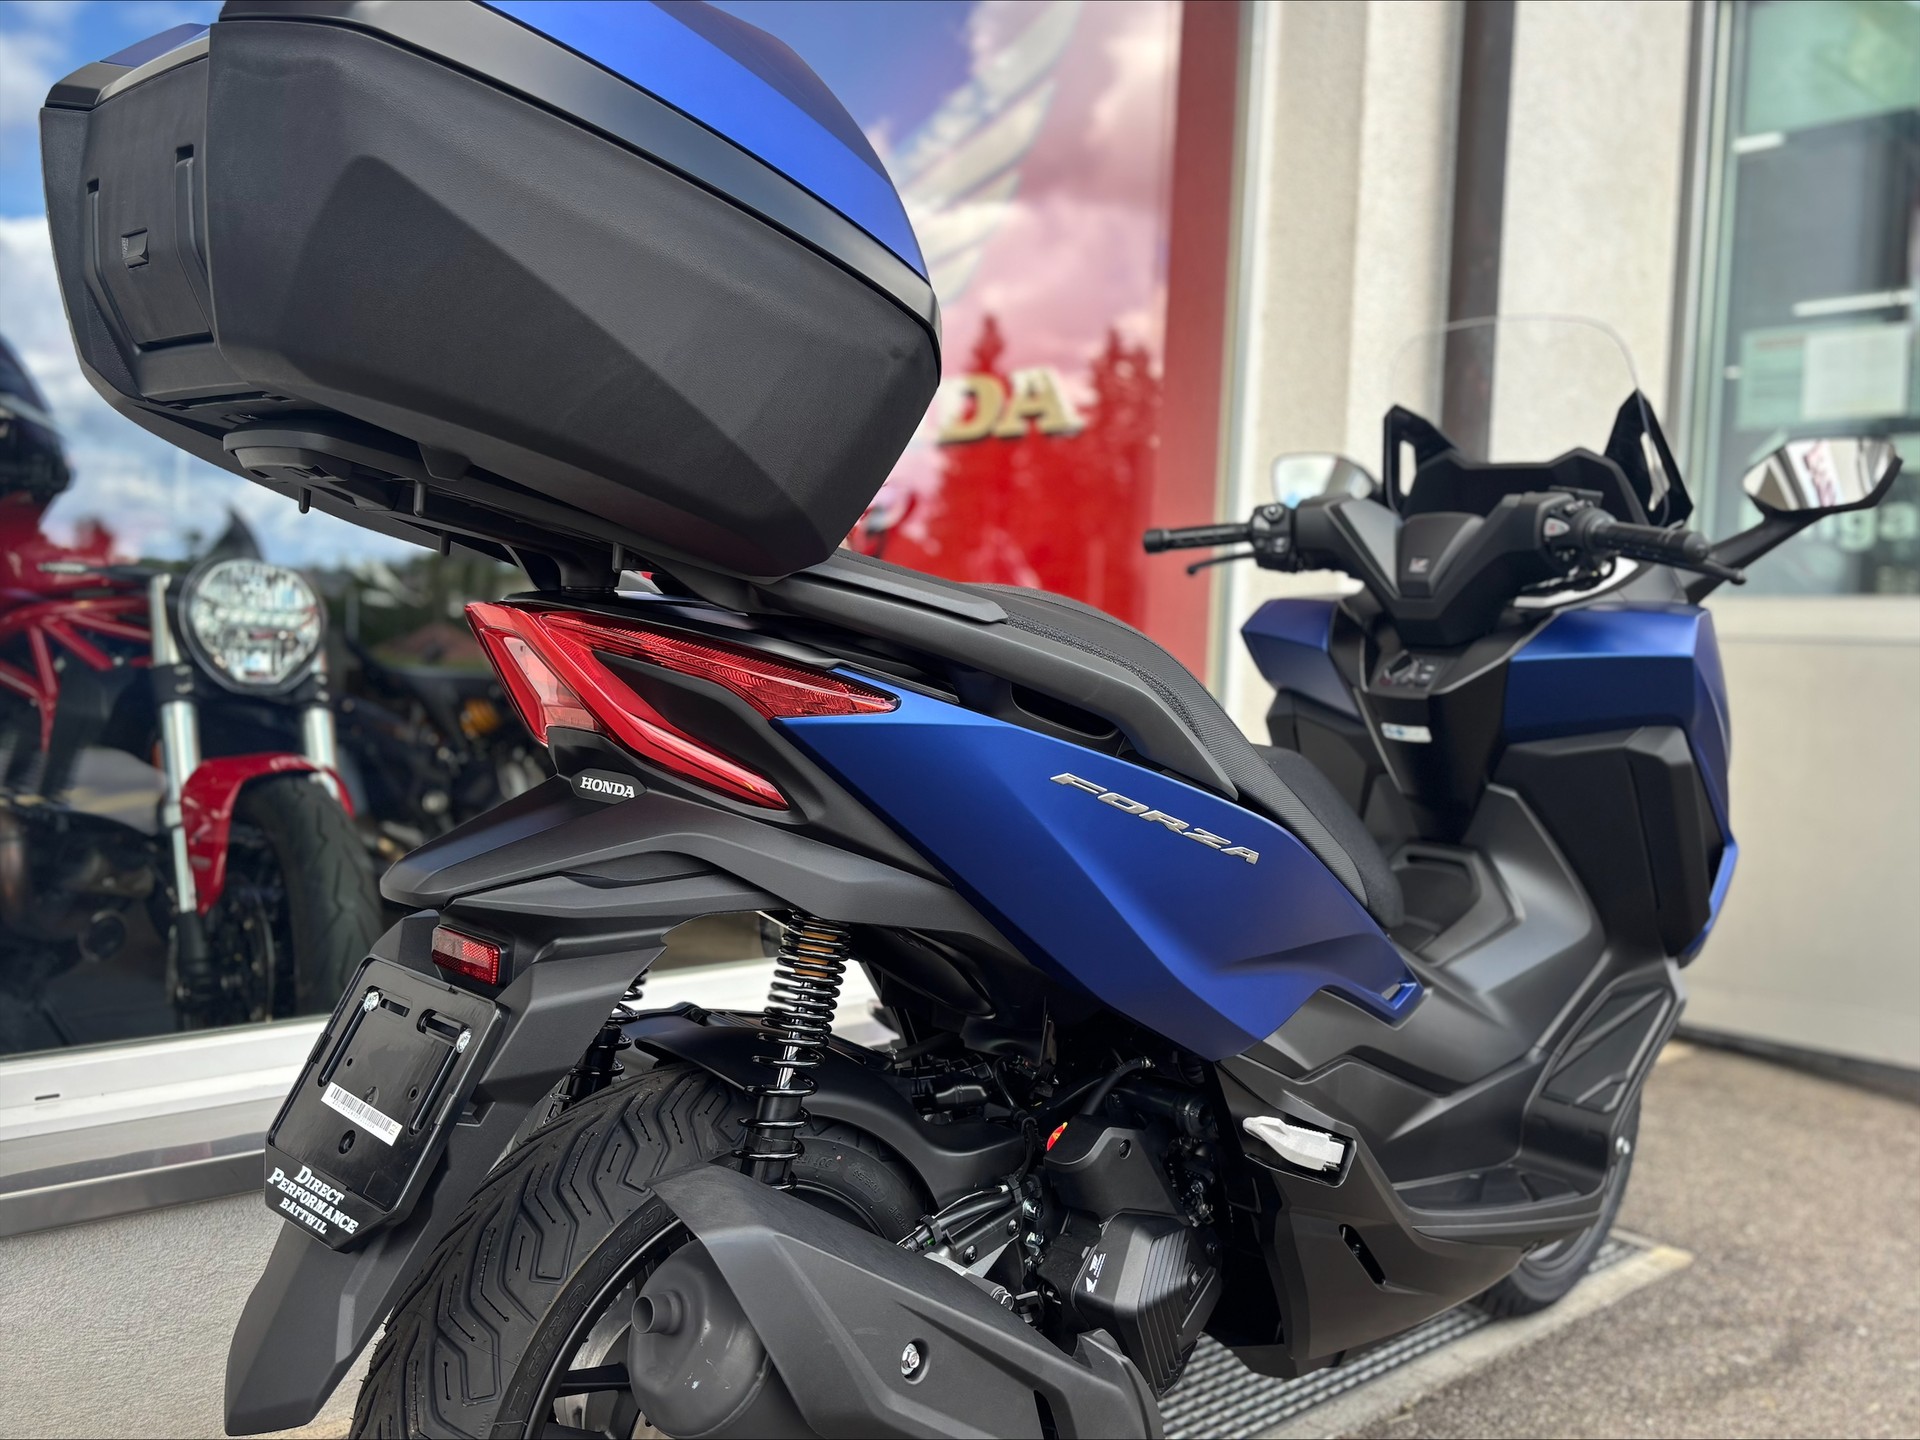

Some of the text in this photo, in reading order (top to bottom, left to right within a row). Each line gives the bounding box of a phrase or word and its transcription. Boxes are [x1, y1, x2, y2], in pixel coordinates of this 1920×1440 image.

[580, 776, 636, 799] HONDA
[1050, 772, 1260, 865] FORZA
[267, 1167, 360, 1235] PERFORMANCE
[293, 1165, 346, 1206] DIRECT
[279, 1197, 328, 1235] BATTWIL
